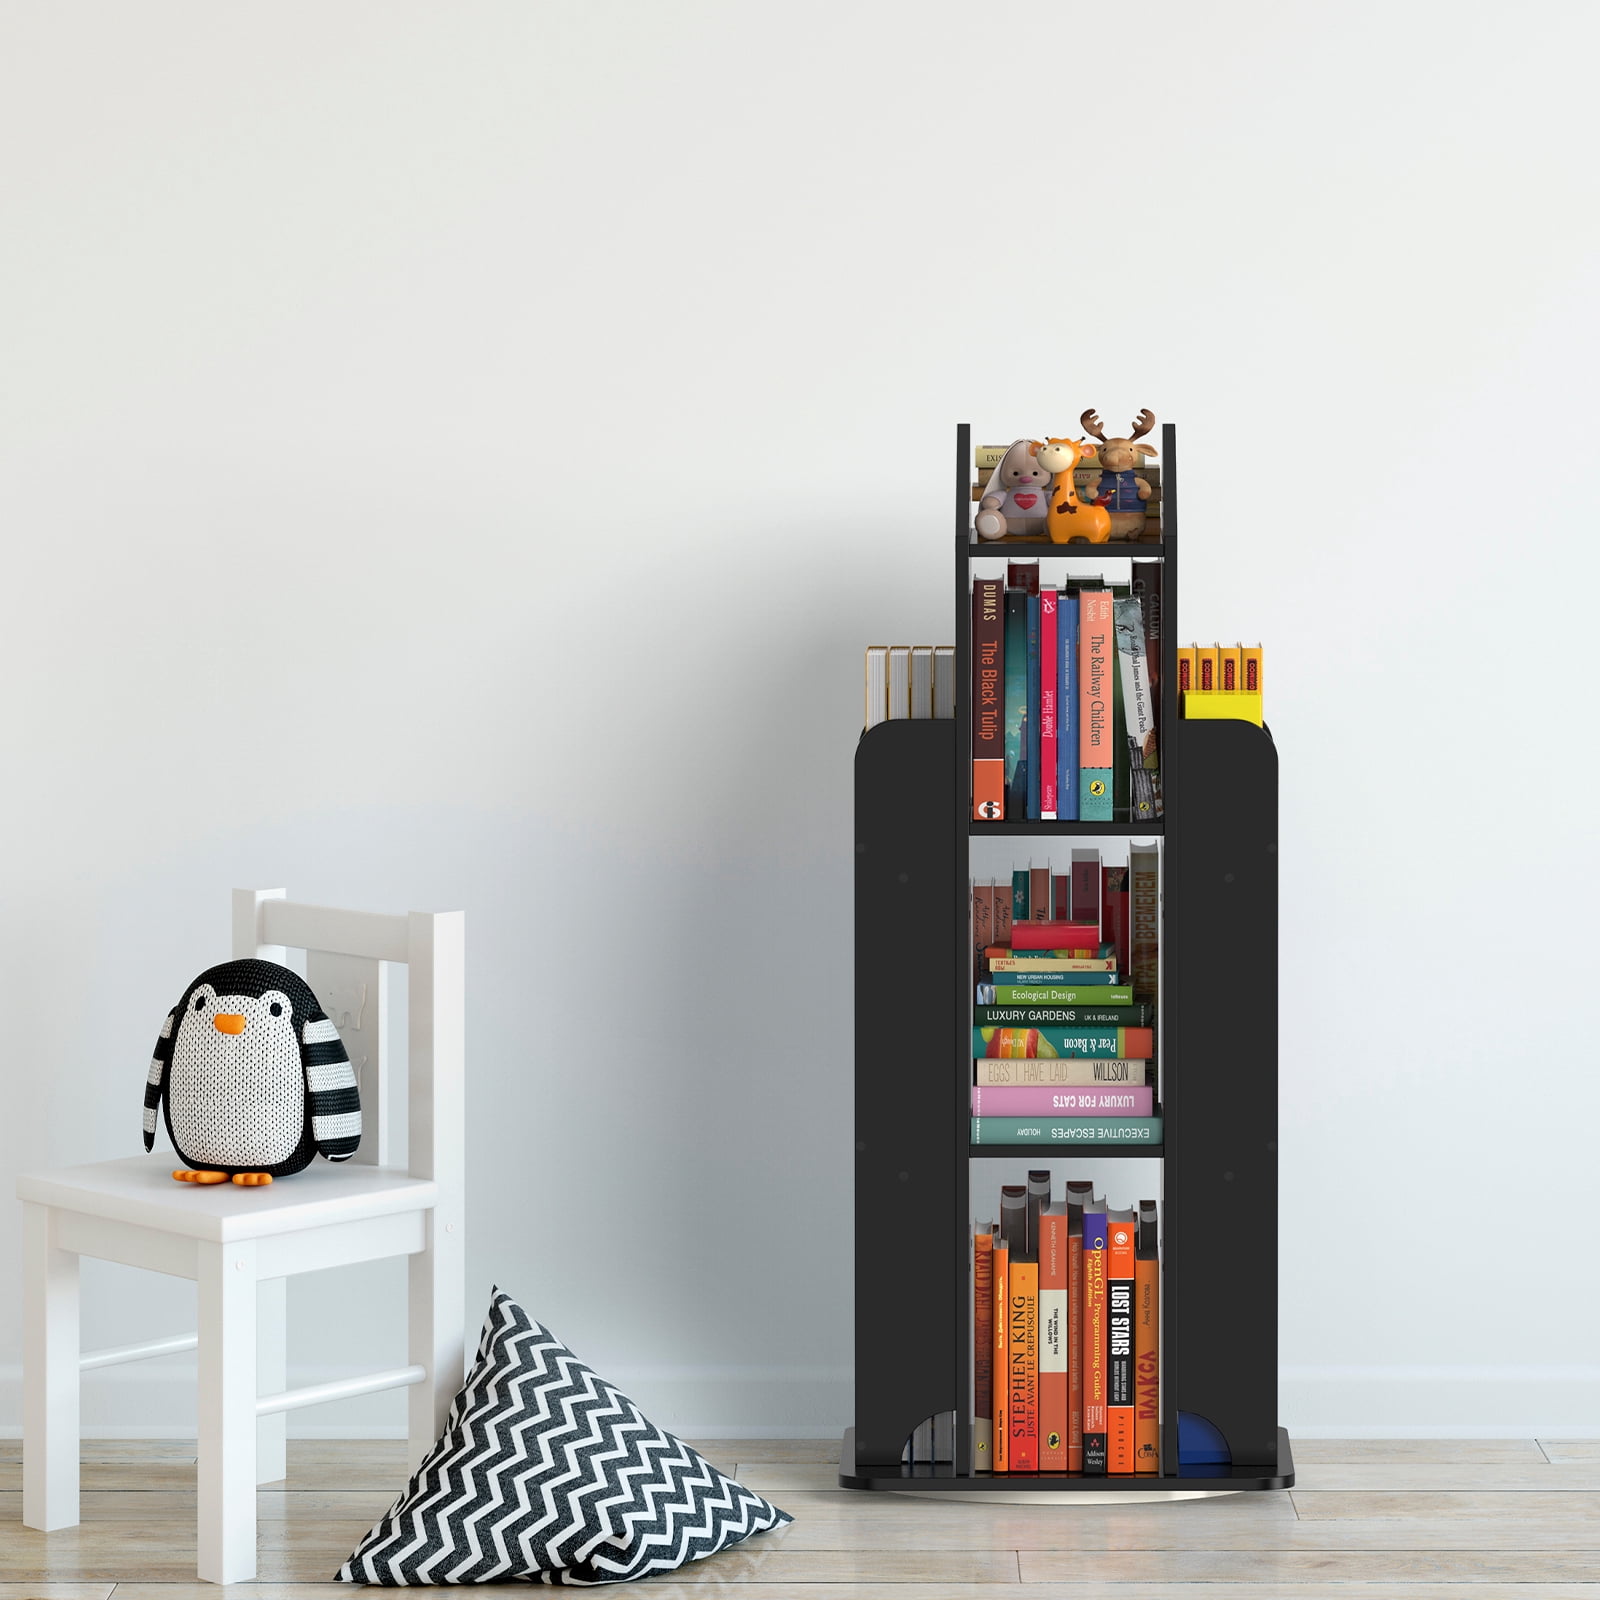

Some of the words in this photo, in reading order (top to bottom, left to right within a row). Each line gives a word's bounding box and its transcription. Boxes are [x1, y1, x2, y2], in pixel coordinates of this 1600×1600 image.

[983, 584, 997, 621] DUMAS
[1100, 600, 1109, 620] Edith
[1149, 593, 1159, 641] CALLUM
[981, 641, 998, 665] The
[1091, 634, 1105, 654] The
[981, 669, 998, 706] Black
[1087, 657, 1105, 698] Railway
[1136, 702, 1145, 717] Giant
[978, 709, 998, 740] Tulip
[1091, 700, 1105, 746] Children
[1138, 717, 1147, 734] Peach
[1012, 990, 1049, 1001] Ecological
[1051, 990, 1077, 1001] Design
[987, 1010, 1026, 1021] LUXURY
[1028, 1010, 1076, 1021] GARDENS
[1064, 1038, 1088, 1053] Bacon
[1089, 1038, 1097, 1053] &
[1097, 1038, 1117, 1053] Pear
[988, 1063, 1010, 1082] EGGS
[1015, 1063, 1018, 1081] I
[1023, 1063, 1045, 1082] HAVE
[1049, 1063, 1068, 1082] LAID
[1093, 1062, 1129, 1081] WILLSON
[1053, 1095, 1076, 1108] CATS
[1078, 1095, 1096, 1108] FOR
[1099, 1095, 1135, 1108] LUXURY
[1017, 1128, 1041, 1136] HOLIDAY
[1051, 1128, 1095, 1139] ESCAPES
[1097, 1128, 1150, 1139] EXECUTIVE
[1091, 1237, 1104, 1297] OpenGL
[1111, 1286, 1130, 1314] LOST
[1012, 1296, 1026, 1343] KING
[1027, 1296, 1035, 1357] CREPUSCULE
[1092, 1303, 1101, 1369] Programming
[1111, 1317, 1130, 1355] STARS
[1027, 1360, 1035, 1371] LE
[1012, 1352, 1026, 1438] STEPHEN
[1027, 1374, 1035, 1406] AVANT
[1094, 1371, 1102, 1400] Guide
[1137, 1350, 1159, 1420] ПЛАКСА
[1027, 1409, 1037, 1438] JUSTE
[1085, 1449, 1104, 1457] Addison
[1087, 1458, 1103, 1466] Wesley
